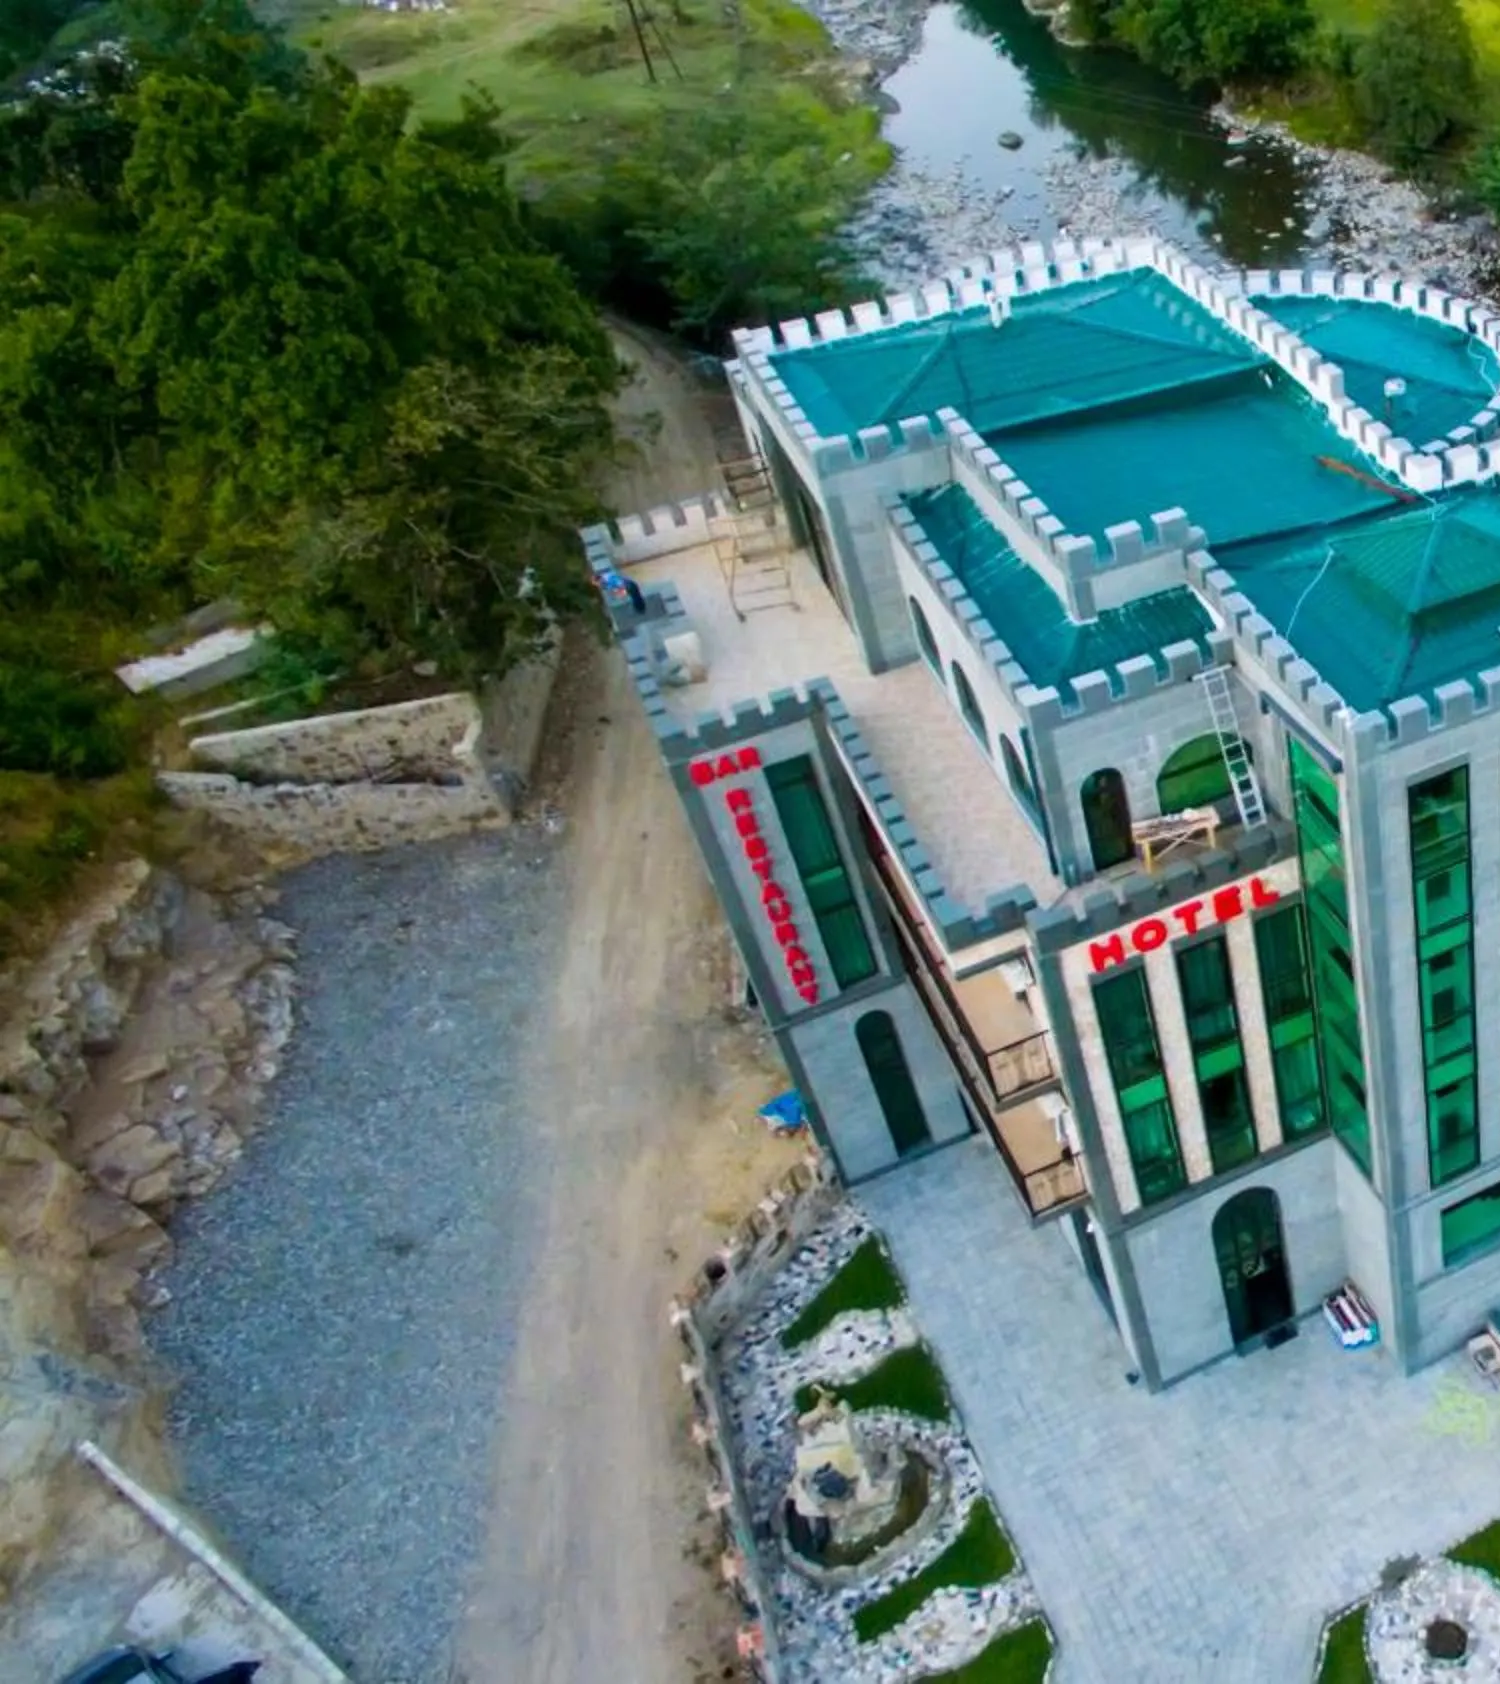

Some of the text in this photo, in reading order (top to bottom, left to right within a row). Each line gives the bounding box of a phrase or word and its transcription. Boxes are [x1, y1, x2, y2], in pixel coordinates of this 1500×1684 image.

[689, 747, 761, 786] BAR
[726, 788, 819, 1004] RESTAURANT
[1089, 877, 1280, 973] HOTEL
